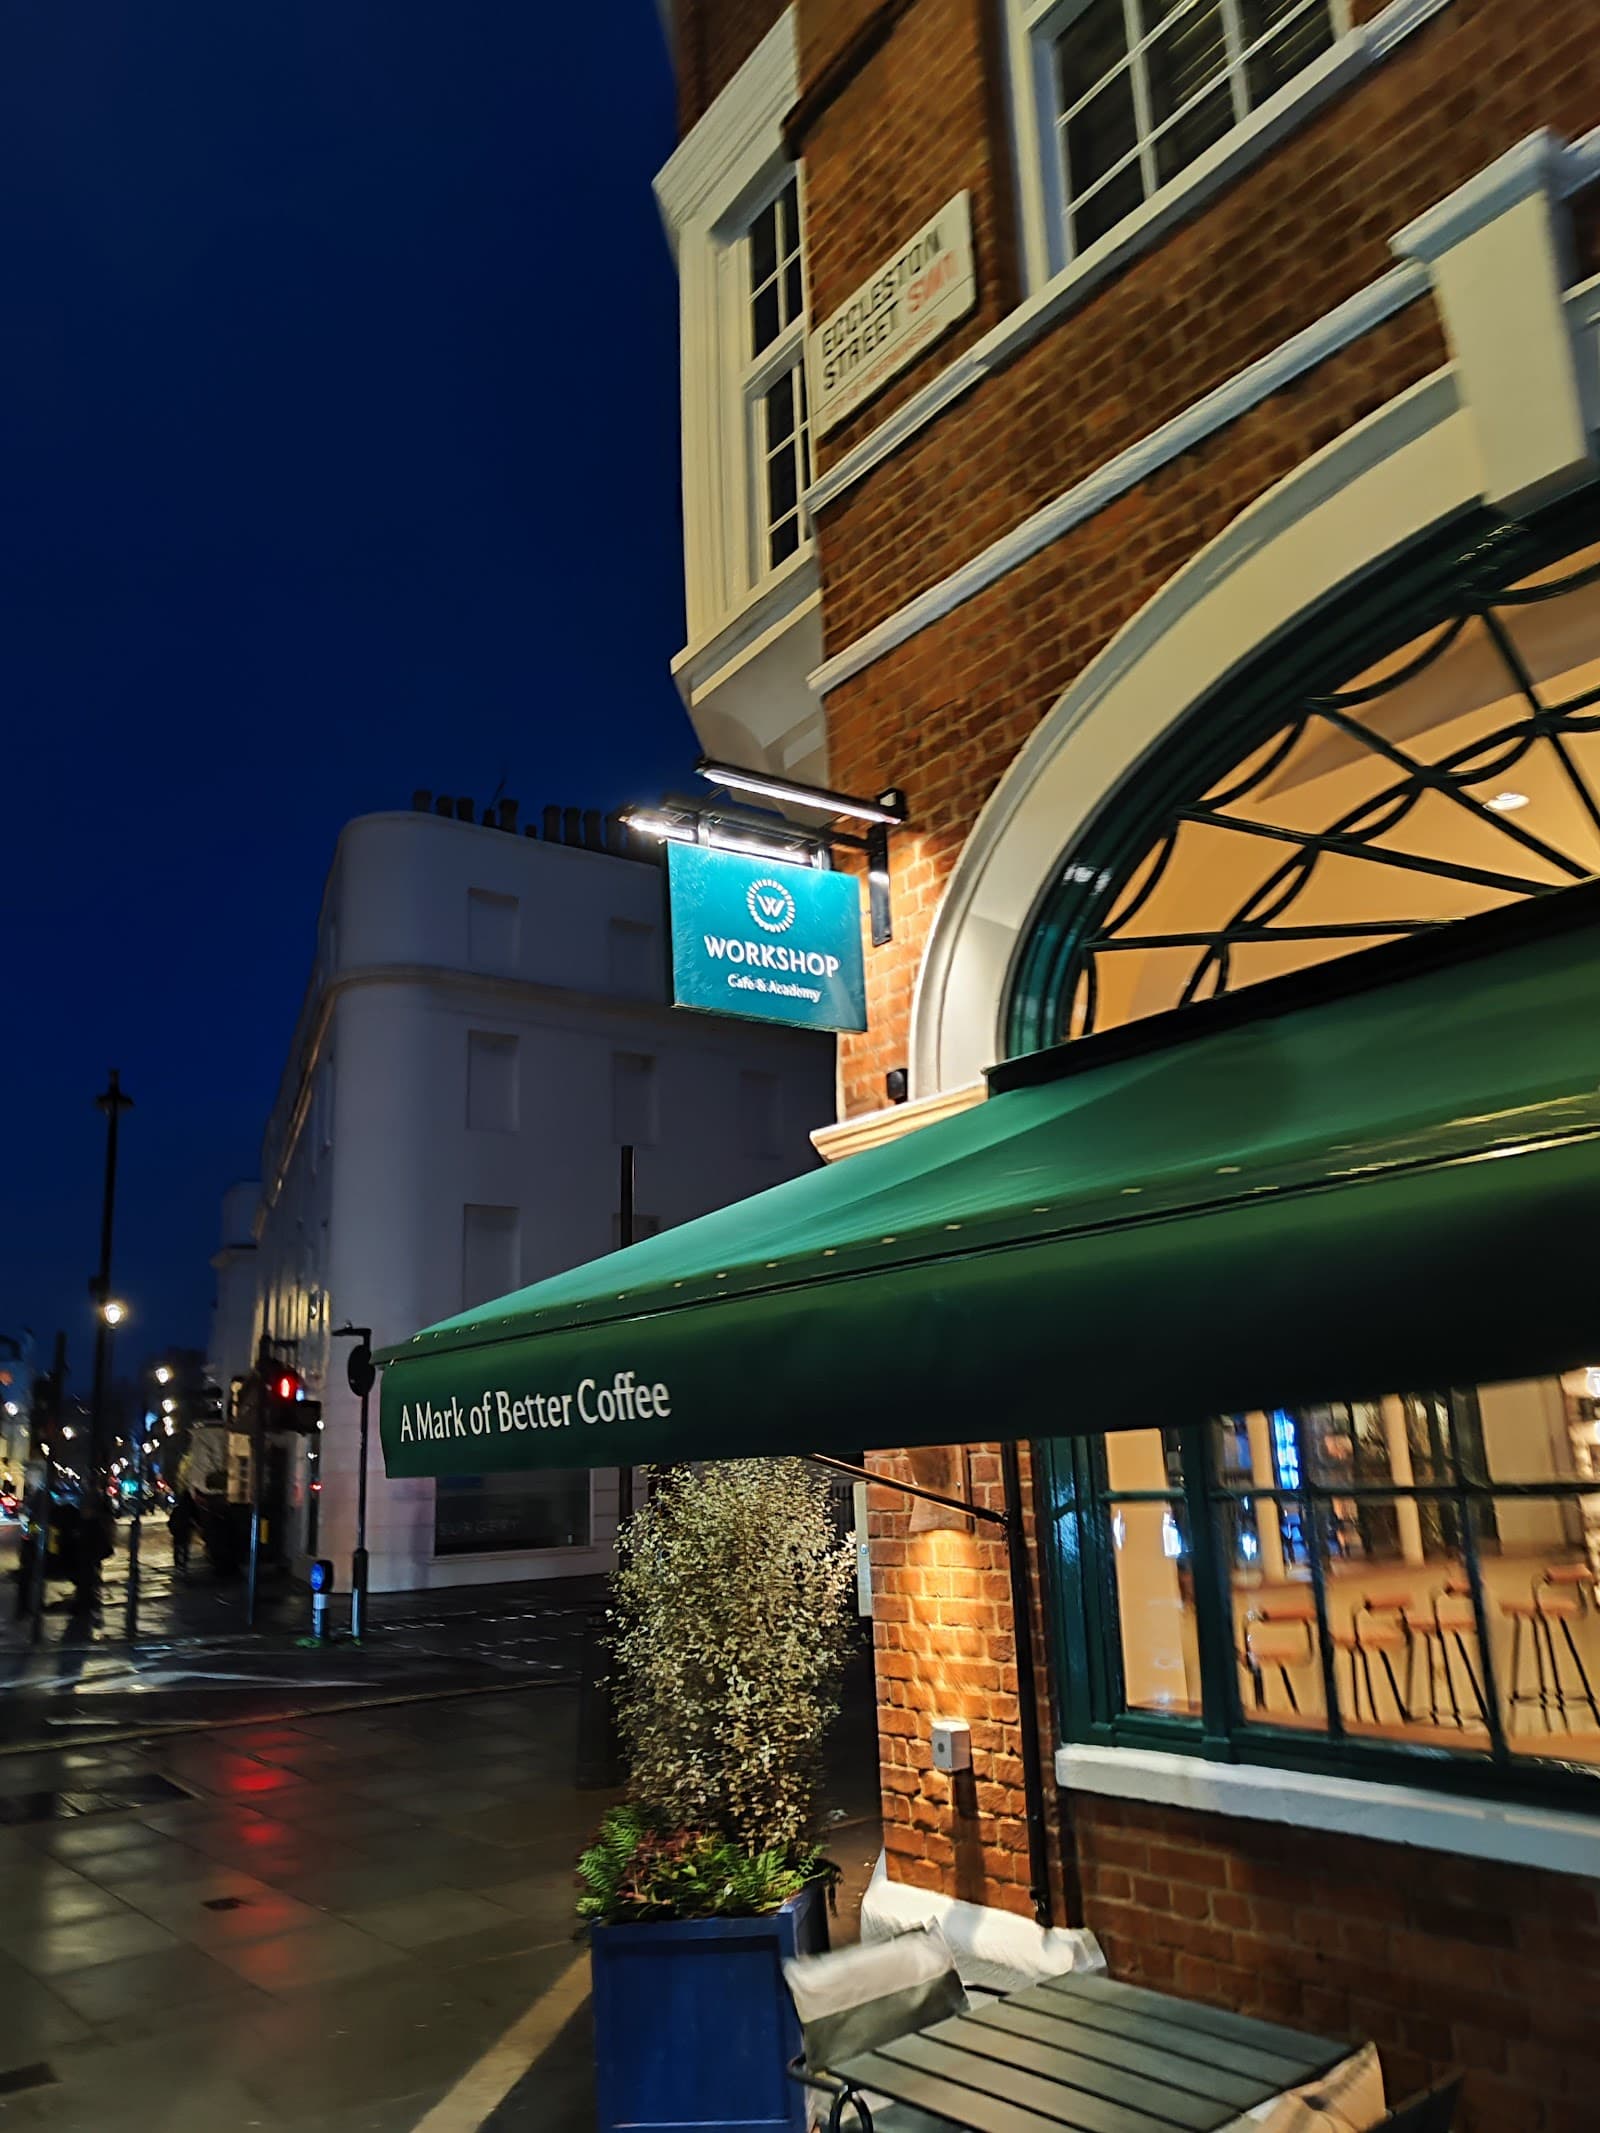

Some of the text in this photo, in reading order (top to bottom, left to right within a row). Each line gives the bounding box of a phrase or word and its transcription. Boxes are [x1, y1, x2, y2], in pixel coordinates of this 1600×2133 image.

[822, 227, 943, 358] ECCLESTON
[824, 299, 899, 391] STREET
[757, 895, 785, 917] W
[704, 934, 839, 977] WORKSHOP
[756, 978, 768, 991] &
[768, 979, 821, 1003] Academy
[400, 1371, 672, 1443] A Mark of Better Coffee
